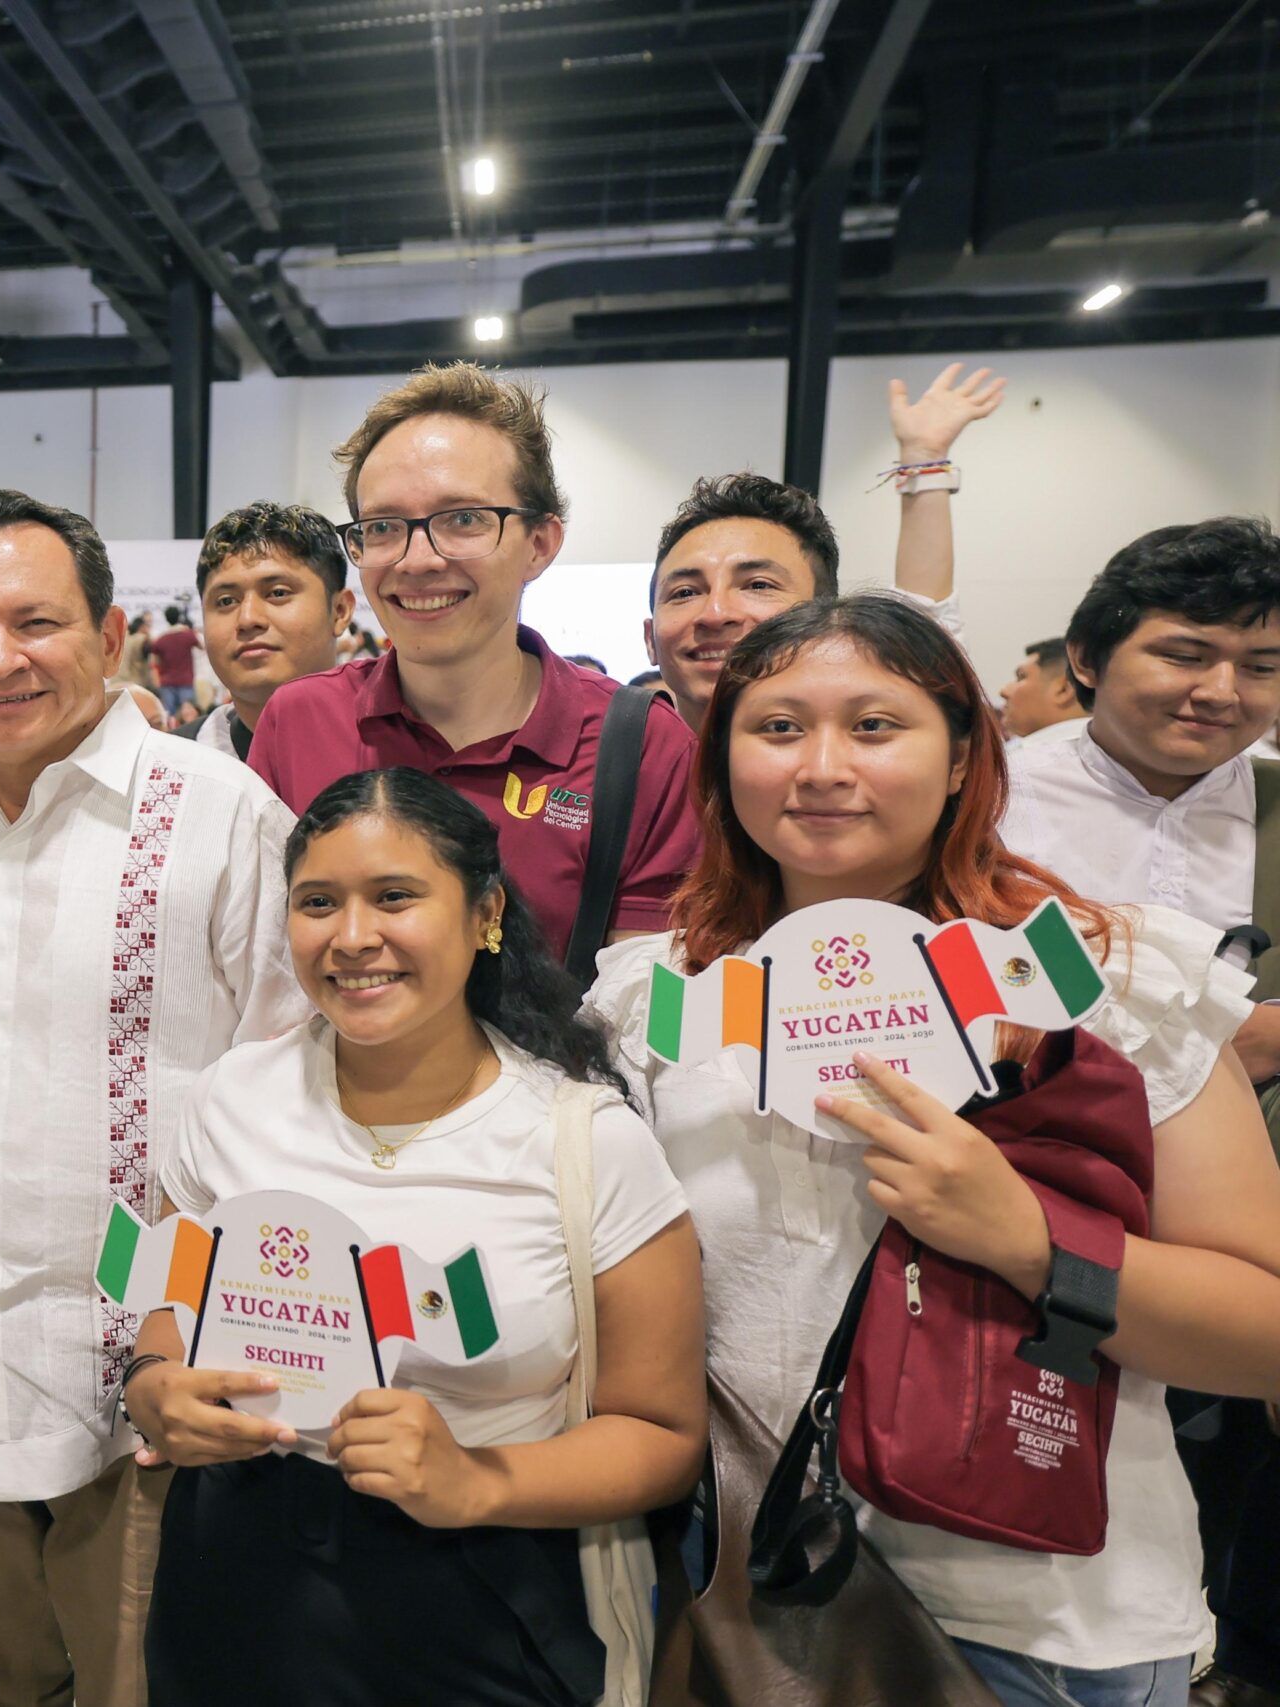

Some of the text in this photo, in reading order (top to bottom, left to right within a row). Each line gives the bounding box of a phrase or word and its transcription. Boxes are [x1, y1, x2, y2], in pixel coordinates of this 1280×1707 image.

[546, 800, 589, 817] Universidad
[543, 816, 582, 830] del Centro
[778, 990, 926, 1015] RENACIMIENTO MAYA
[781, 1004, 930, 1039] YUCATÁN
[786, 1042, 825, 1052] GOBIERNO
[844, 1036, 874, 1046] ESTADO
[884, 1033, 906, 1041] 2024
[912, 1029, 934, 1038] 2030
[818, 1058, 911, 1082] SECTI
[220, 1279, 351, 1305] RENACIMIENTO MAYA
[220, 1293, 350, 1330] YUCATÁN
[220, 1317, 256, 1328] GOBIERNO
[258, 1322, 271, 1330] DEL
[273, 1325, 299, 1335] ESTADO
[245, 1344, 325, 1371] SECIHTI
[1010, 1399, 1078, 1434] YUCATÁN
[1017, 1430, 1064, 1456] SECIHTI
